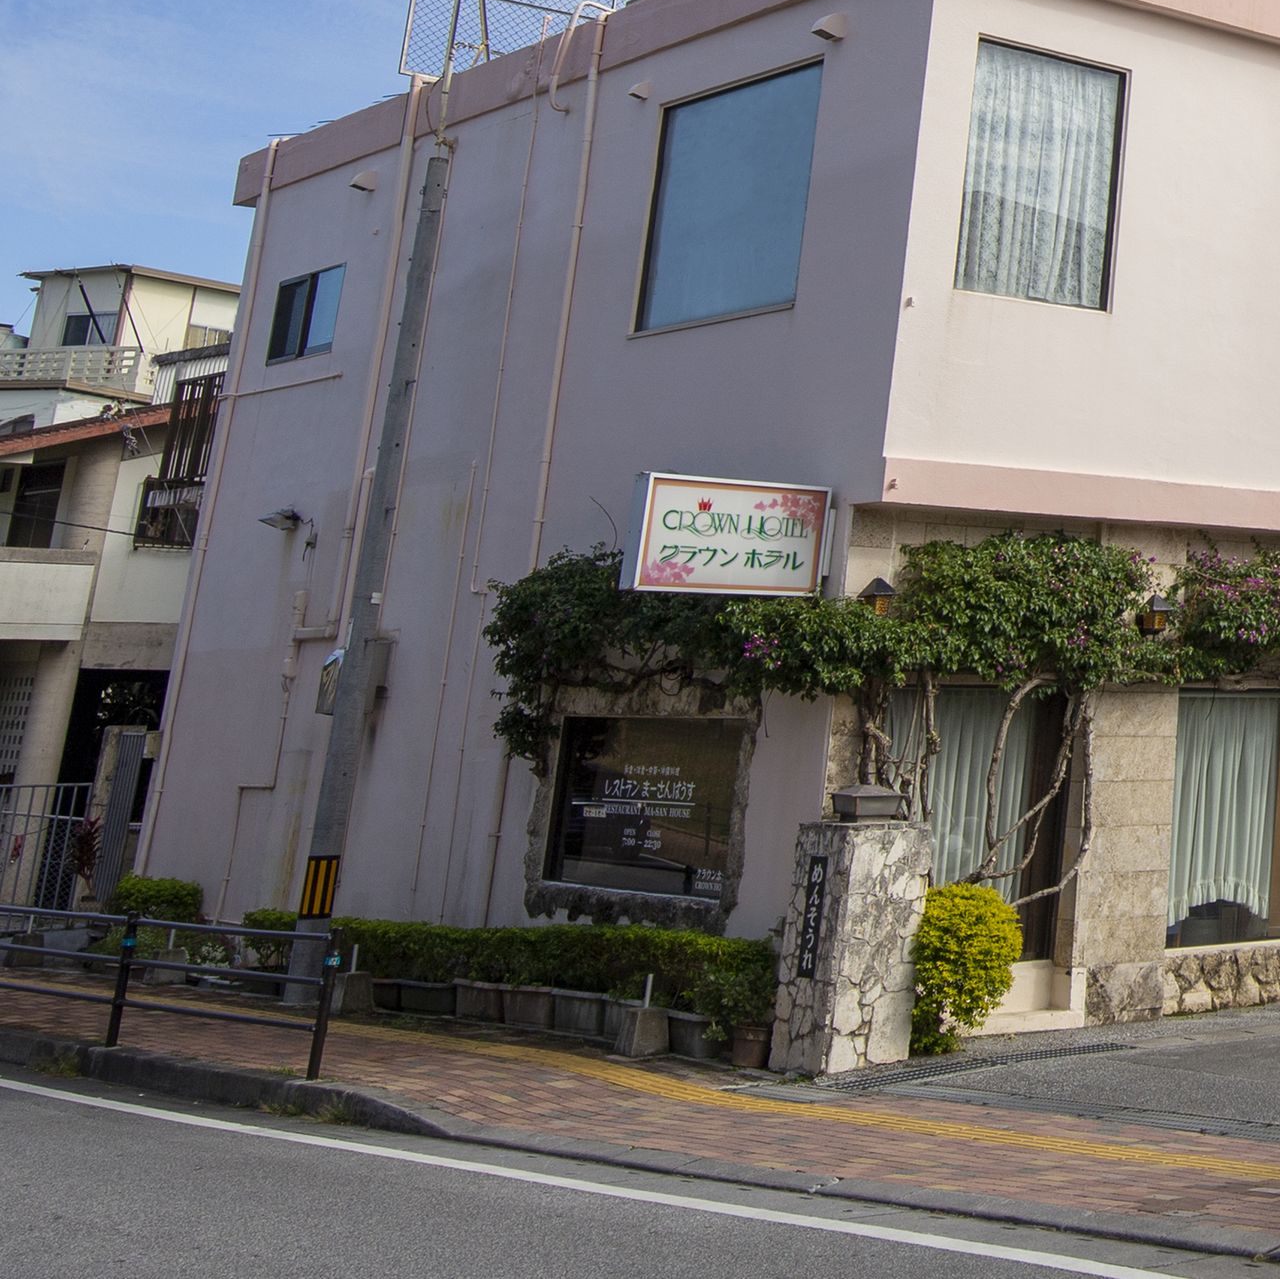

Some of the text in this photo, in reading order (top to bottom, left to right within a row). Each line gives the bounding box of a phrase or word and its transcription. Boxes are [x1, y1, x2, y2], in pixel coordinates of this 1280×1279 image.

[662, 509, 808, 542] CROWN HOTEL
[659, 544, 804, 571] クラウン ホテル
[604, 778, 696, 800] レストラン まーさんはうす
[669, 807, 691, 818] HOUSE
[801, 863, 823, 970] めんそうれ
